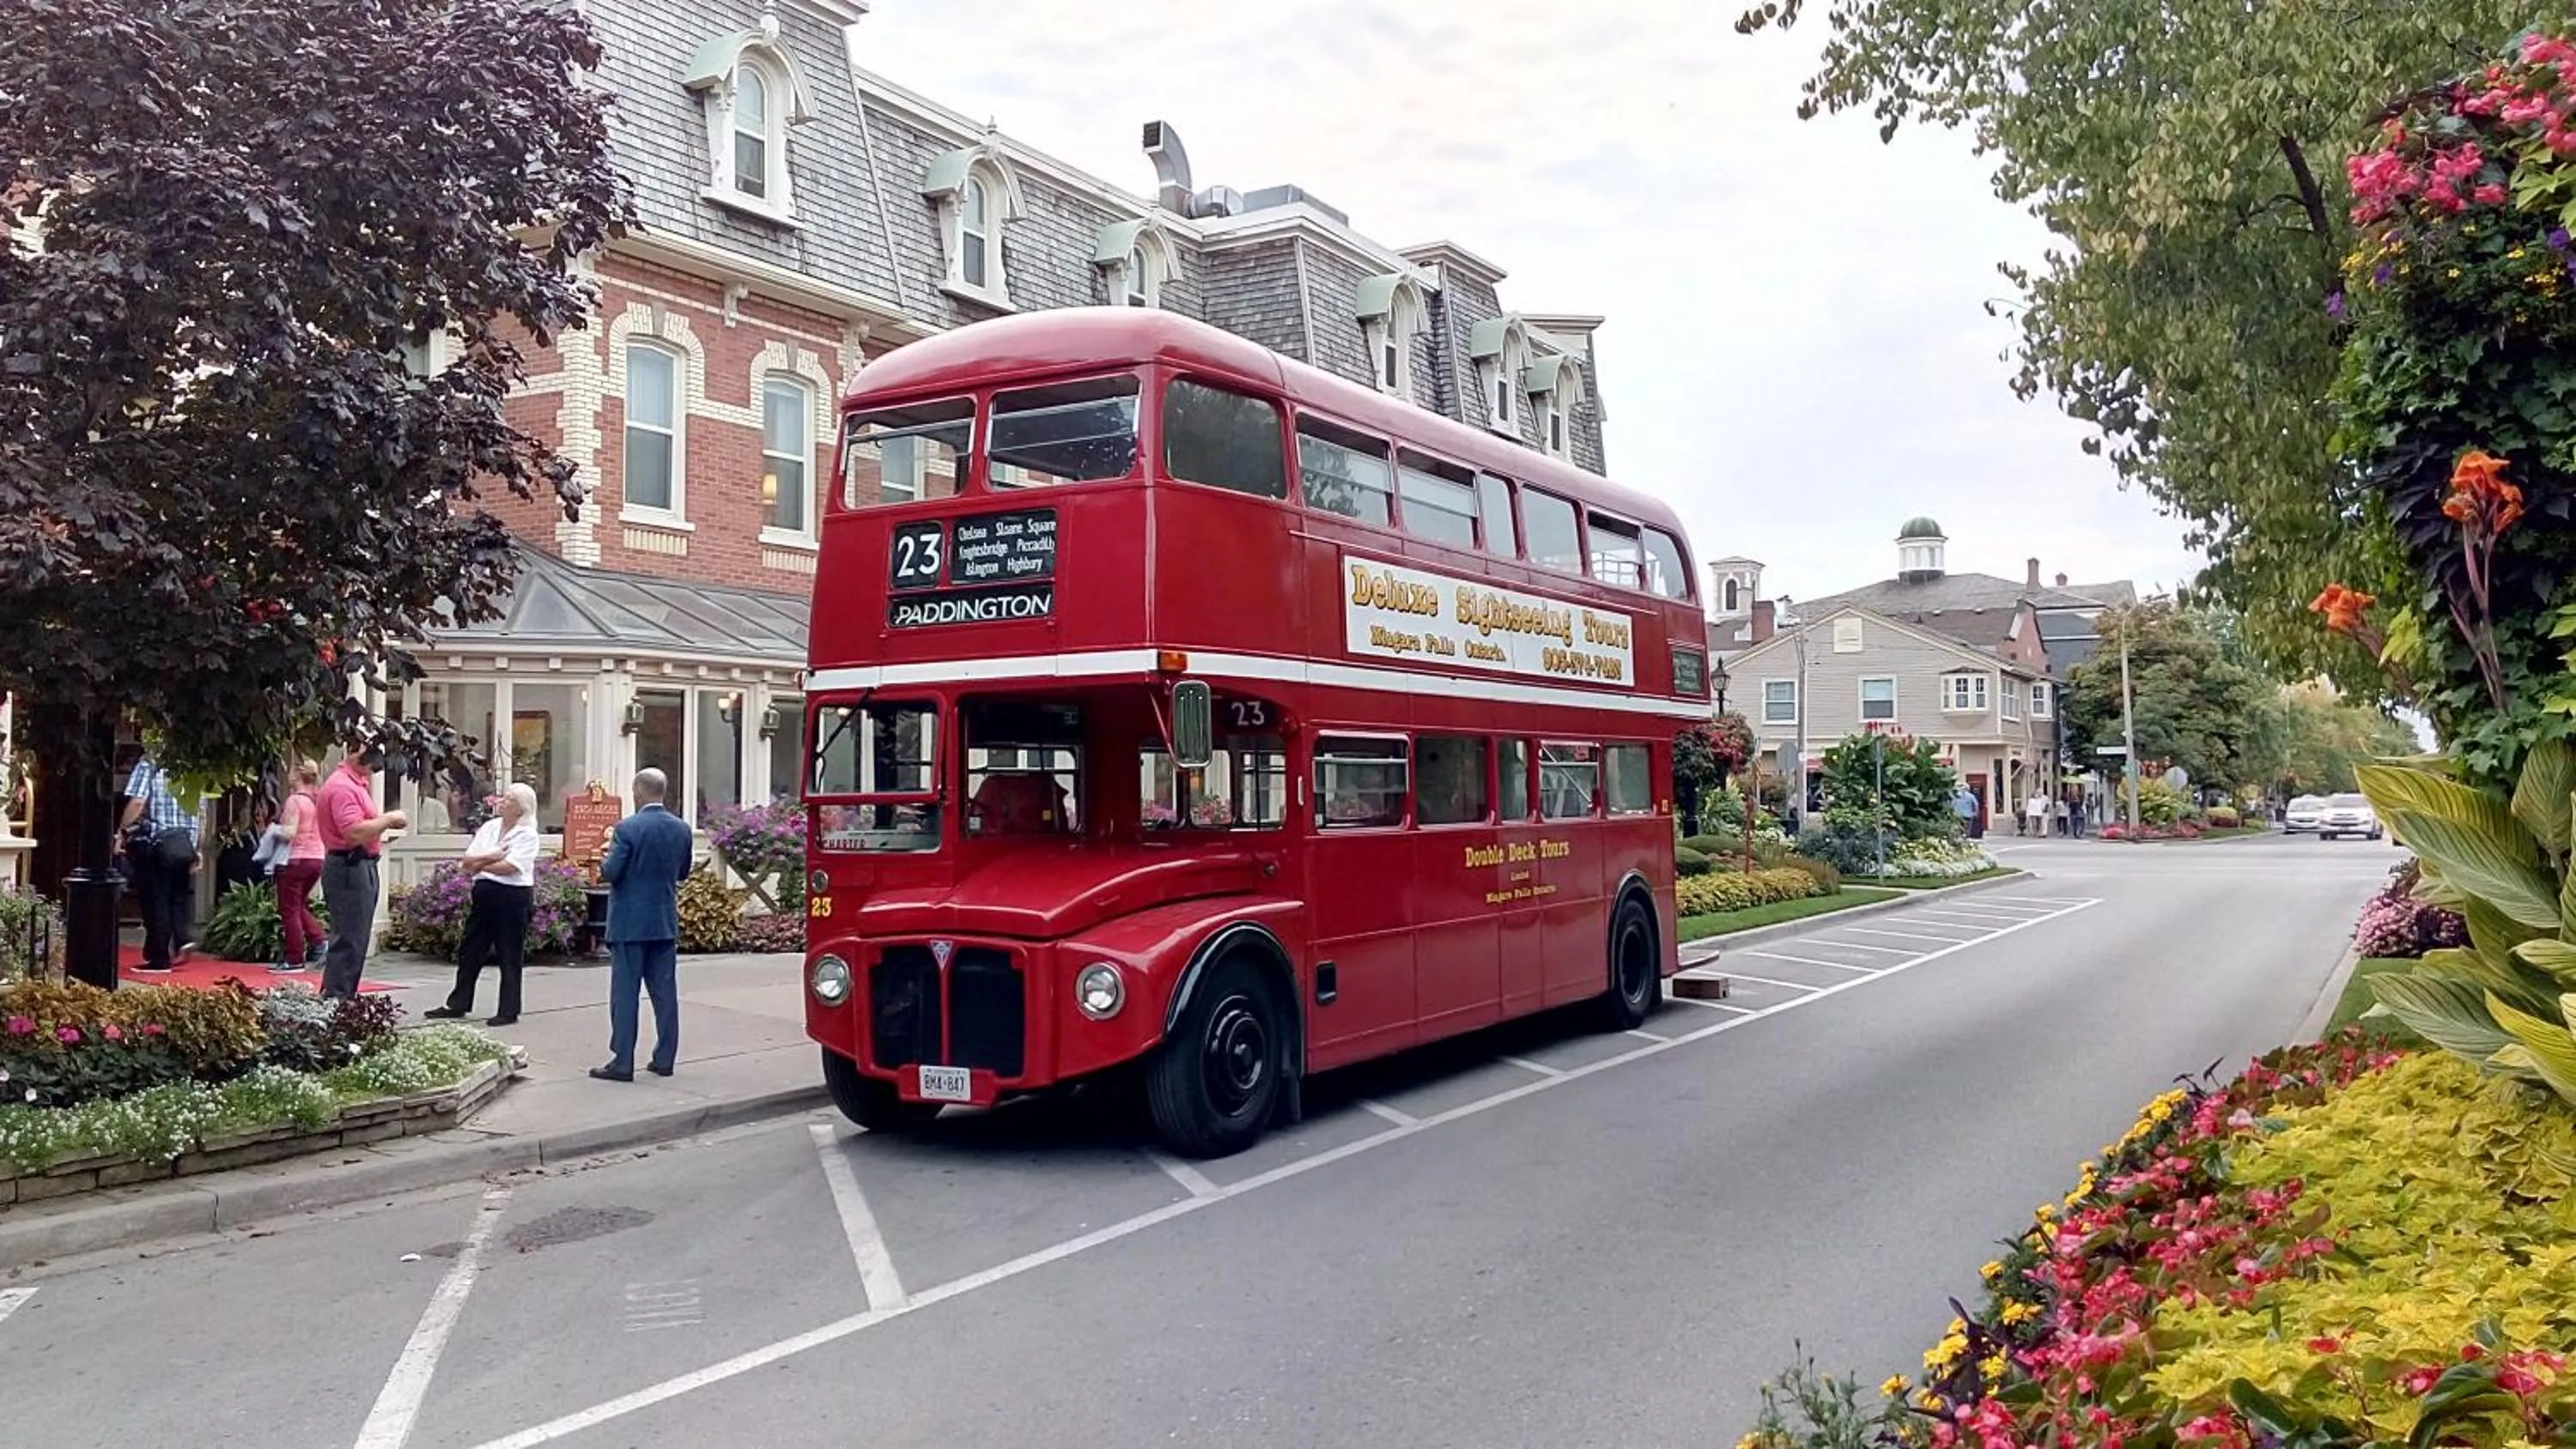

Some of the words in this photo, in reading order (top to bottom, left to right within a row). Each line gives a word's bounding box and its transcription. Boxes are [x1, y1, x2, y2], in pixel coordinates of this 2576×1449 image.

[957, 525, 987, 542] Chelsea
[995, 521, 1024, 537] Sloane
[1027, 518, 1056, 534] Square
[896, 533, 942, 578] 23
[959, 539, 1008, 560] Knightsbridge
[1017, 536, 1055, 554] Piccadilly
[964, 561, 999, 578] Islington
[1007, 557, 1042, 573] Highbury
[895, 593, 1052, 625] PADDINGTON
[1352, 564, 1438, 616] Deluxe
[1455, 585, 1573, 646] Sightseeing
[1583, 609, 1629, 649] Tours
[1370, 624, 1420, 653] Niagara
[1425, 632, 1455, 657] Falls
[1230, 700, 1265, 726] 23
[822, 838, 866, 851] CHARTER
[1464, 845, 1504, 868] Double
[1509, 840, 1536, 863] Deck
[1540, 839, 1570, 858] Tours
[811, 897, 832, 917] 23
